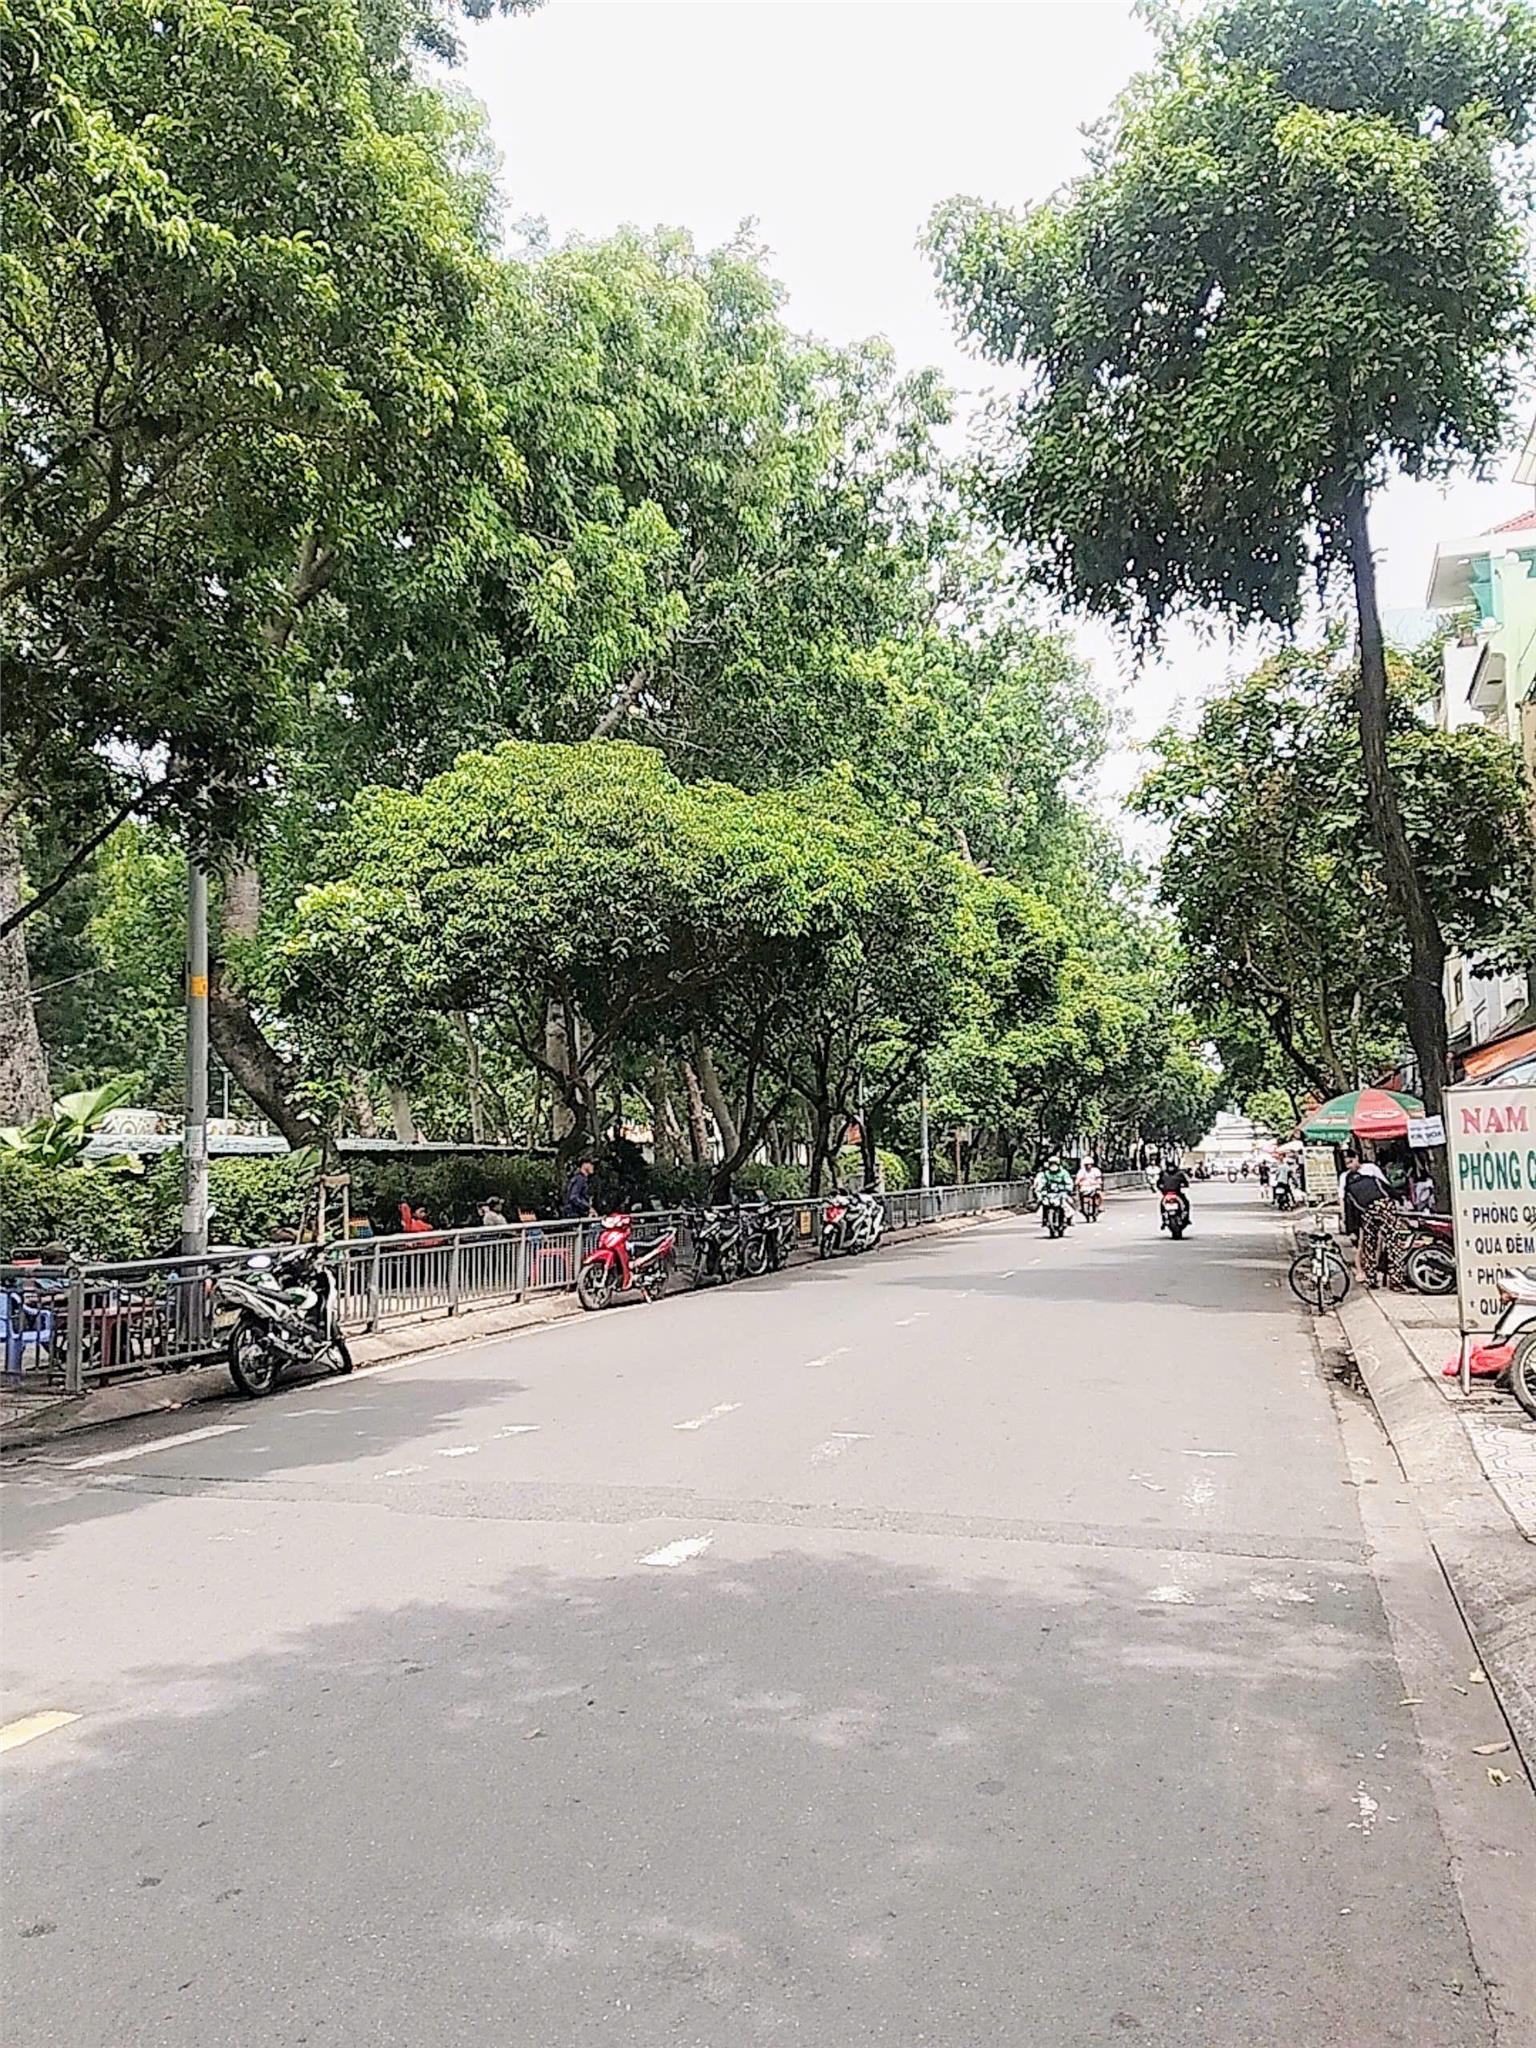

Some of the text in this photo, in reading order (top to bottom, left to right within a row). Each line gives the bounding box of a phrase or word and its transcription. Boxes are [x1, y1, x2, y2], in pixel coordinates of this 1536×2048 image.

[1461, 1106, 1528, 1133] NAM
[1459, 1141, 1521, 1190] PHÒNG
[1472, 1201, 1518, 1223] PHÒNG
[1475, 1238, 1502, 1254] QUA
